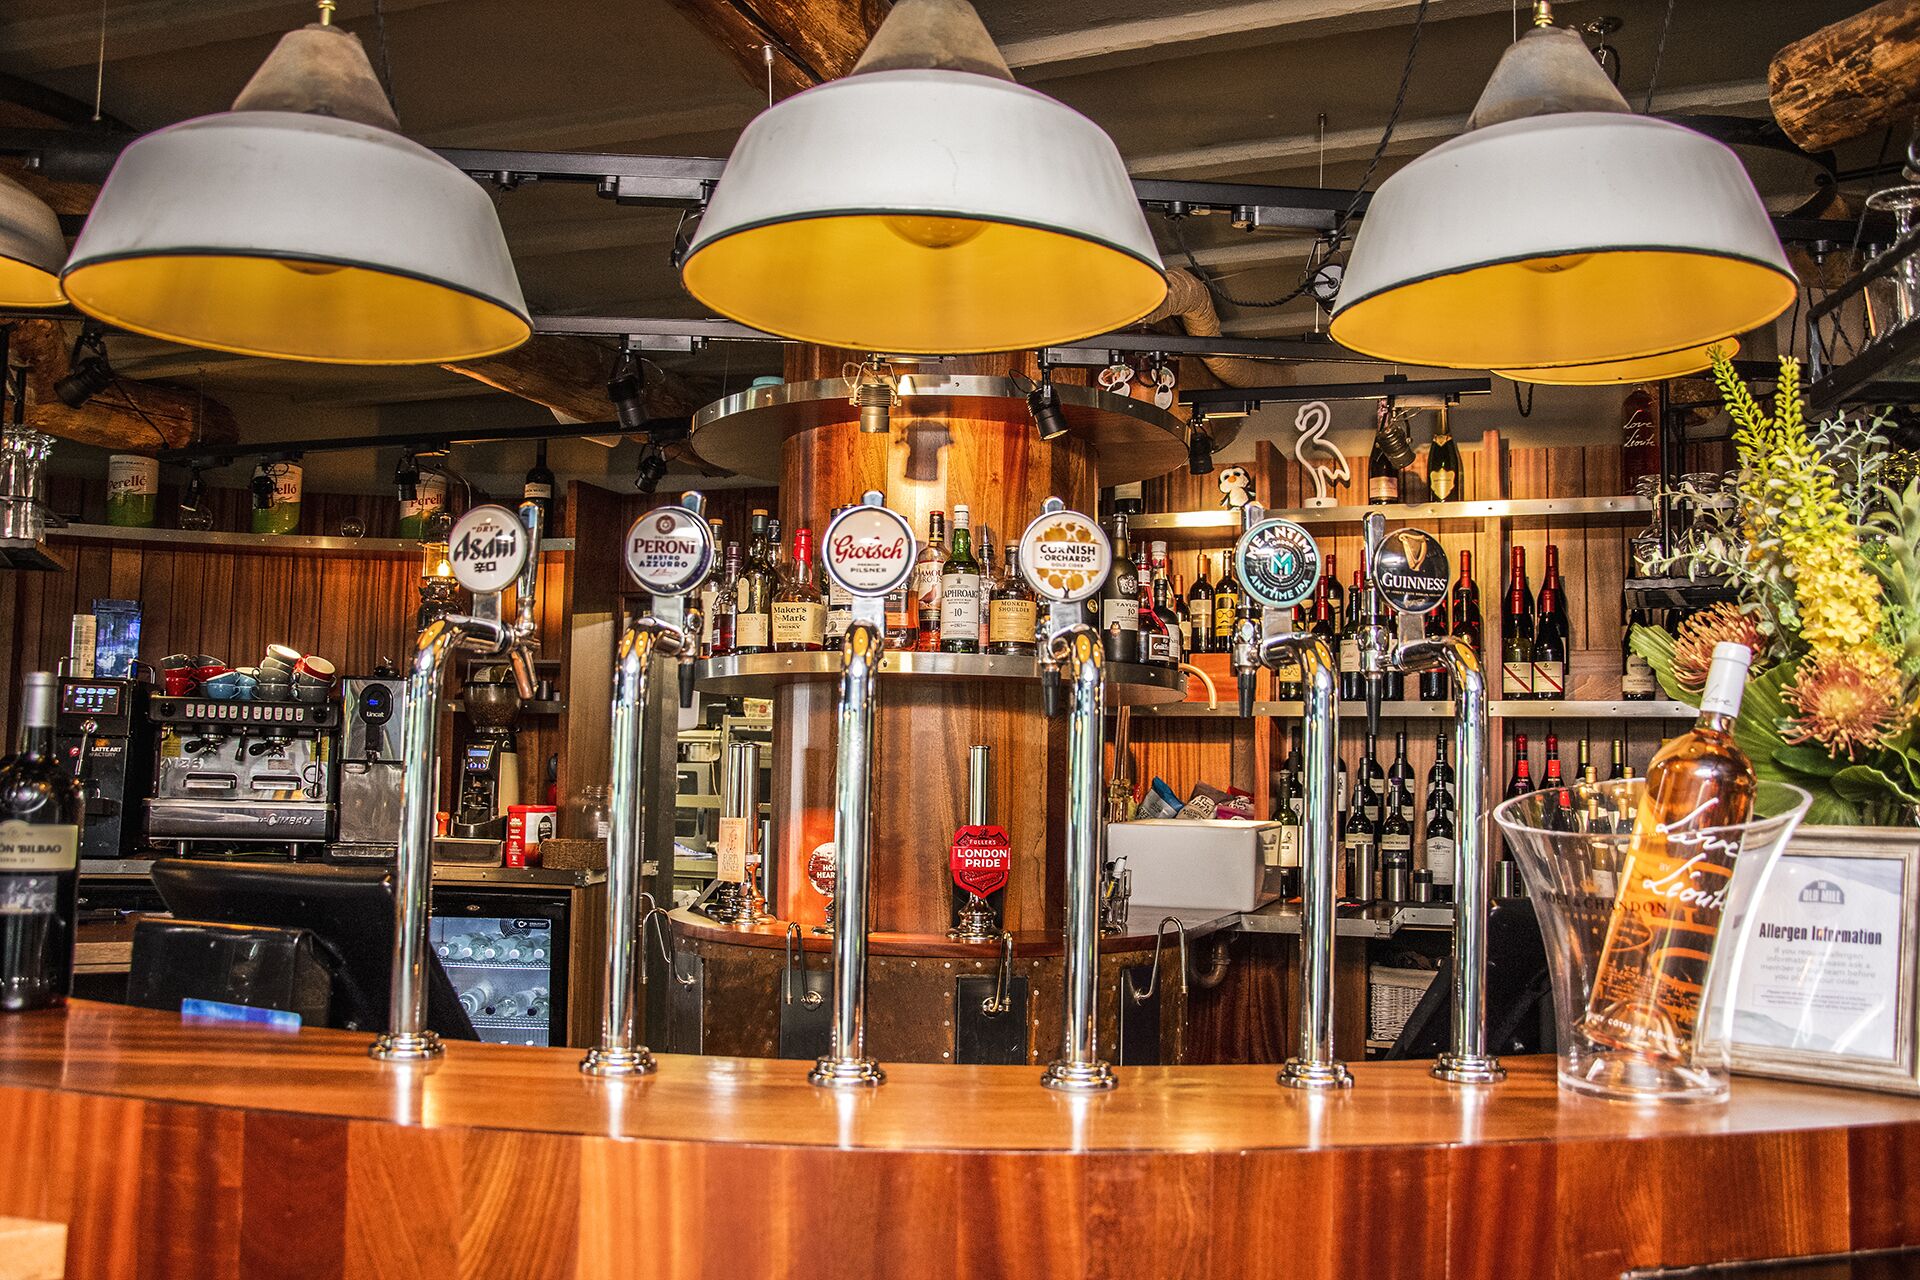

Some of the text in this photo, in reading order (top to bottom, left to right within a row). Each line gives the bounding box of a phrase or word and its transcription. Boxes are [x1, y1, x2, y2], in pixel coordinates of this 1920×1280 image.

[453, 529, 516, 562] Asahi
[1040, 544, 1096, 555] CORNISH
[1246, 526, 1316, 563] MEANTIME
[1382, 572, 1448, 591] GUINNESS
[1249, 575, 1311, 600] ANYTIME IPA
[773, 606, 807, 614] Maker's
[954, 608, 963, 617] 10
[782, 614, 807, 622] Mark
[17, 844, 62, 853] BILBAO
[957, 849, 1007, 858] LONDON
[965, 858, 1001, 868] PRIDE
[1802, 889, 1841, 903] OLD MILL
[1759, 923, 1807, 941] Allergen
